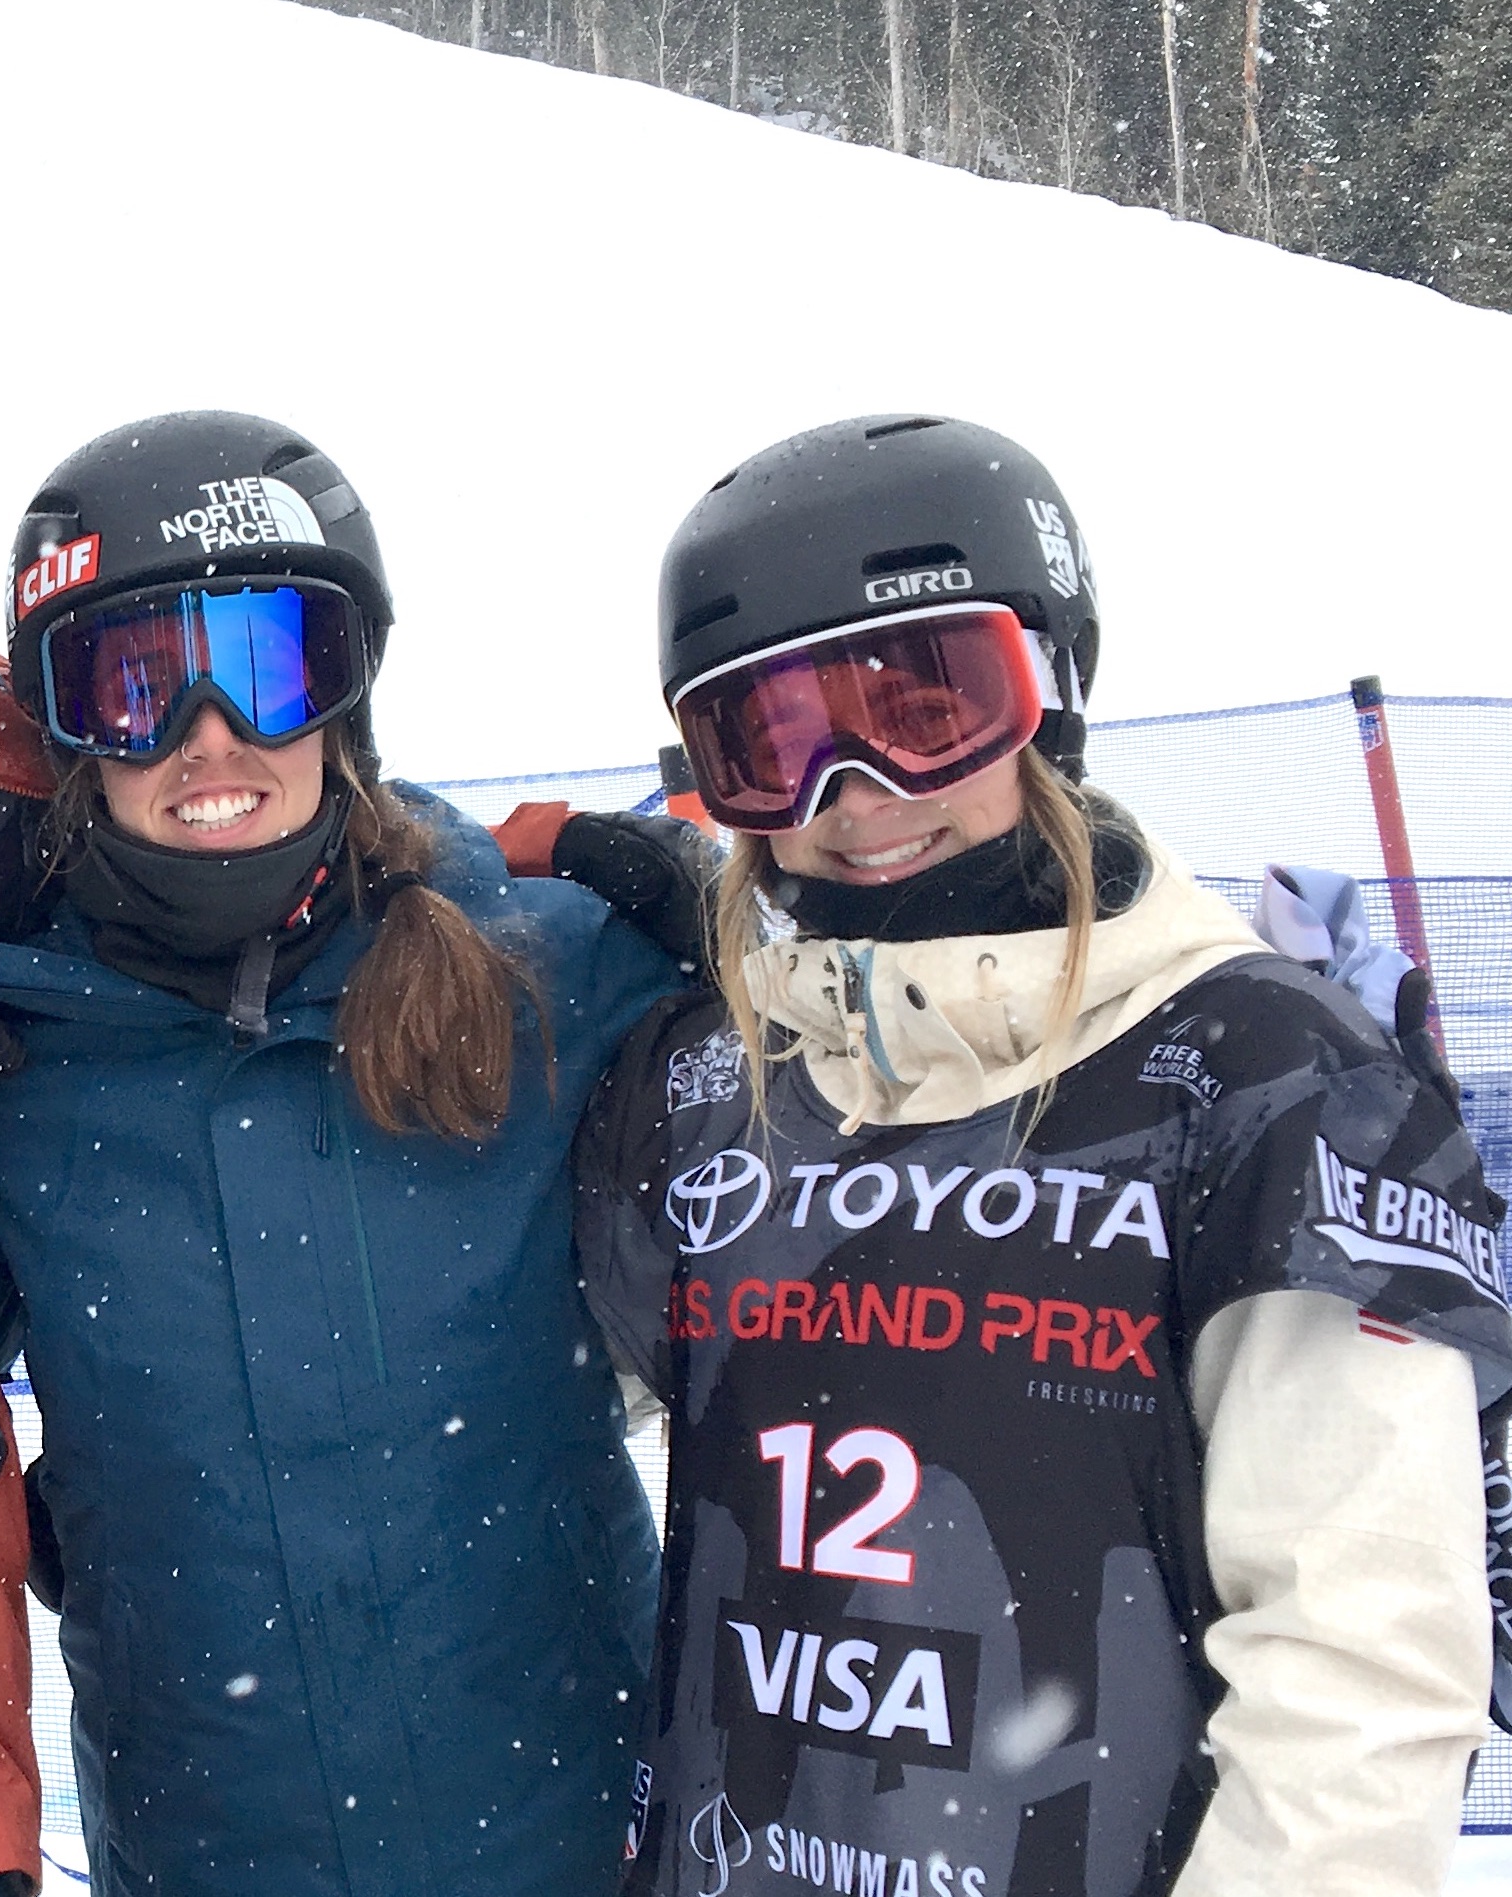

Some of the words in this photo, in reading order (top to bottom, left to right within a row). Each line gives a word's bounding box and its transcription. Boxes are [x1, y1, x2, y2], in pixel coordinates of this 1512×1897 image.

[199, 477, 261, 504] THE
[1025, 498, 1067, 537] US
[159, 500, 271, 543] NORTH
[200, 520, 280, 553] FACE
[23, 540, 92, 607] CLIF
[865, 567, 973, 603] GIRO
[1143, 1061, 1199, 1080] WORLD
[1149, 1043, 1204, 1067] FREE
[1316, 1135, 1368, 1231] ICE
[788, 1163, 1170, 1260] TOYOTA
[727, 1278, 965, 1352] GRAND
[980, 1291, 1162, 1378] PRIX
[757, 1421, 923, 1586] 12
[726, 1619, 953, 1748] VISA
[767, 1823, 988, 1897] SNOWMASS
